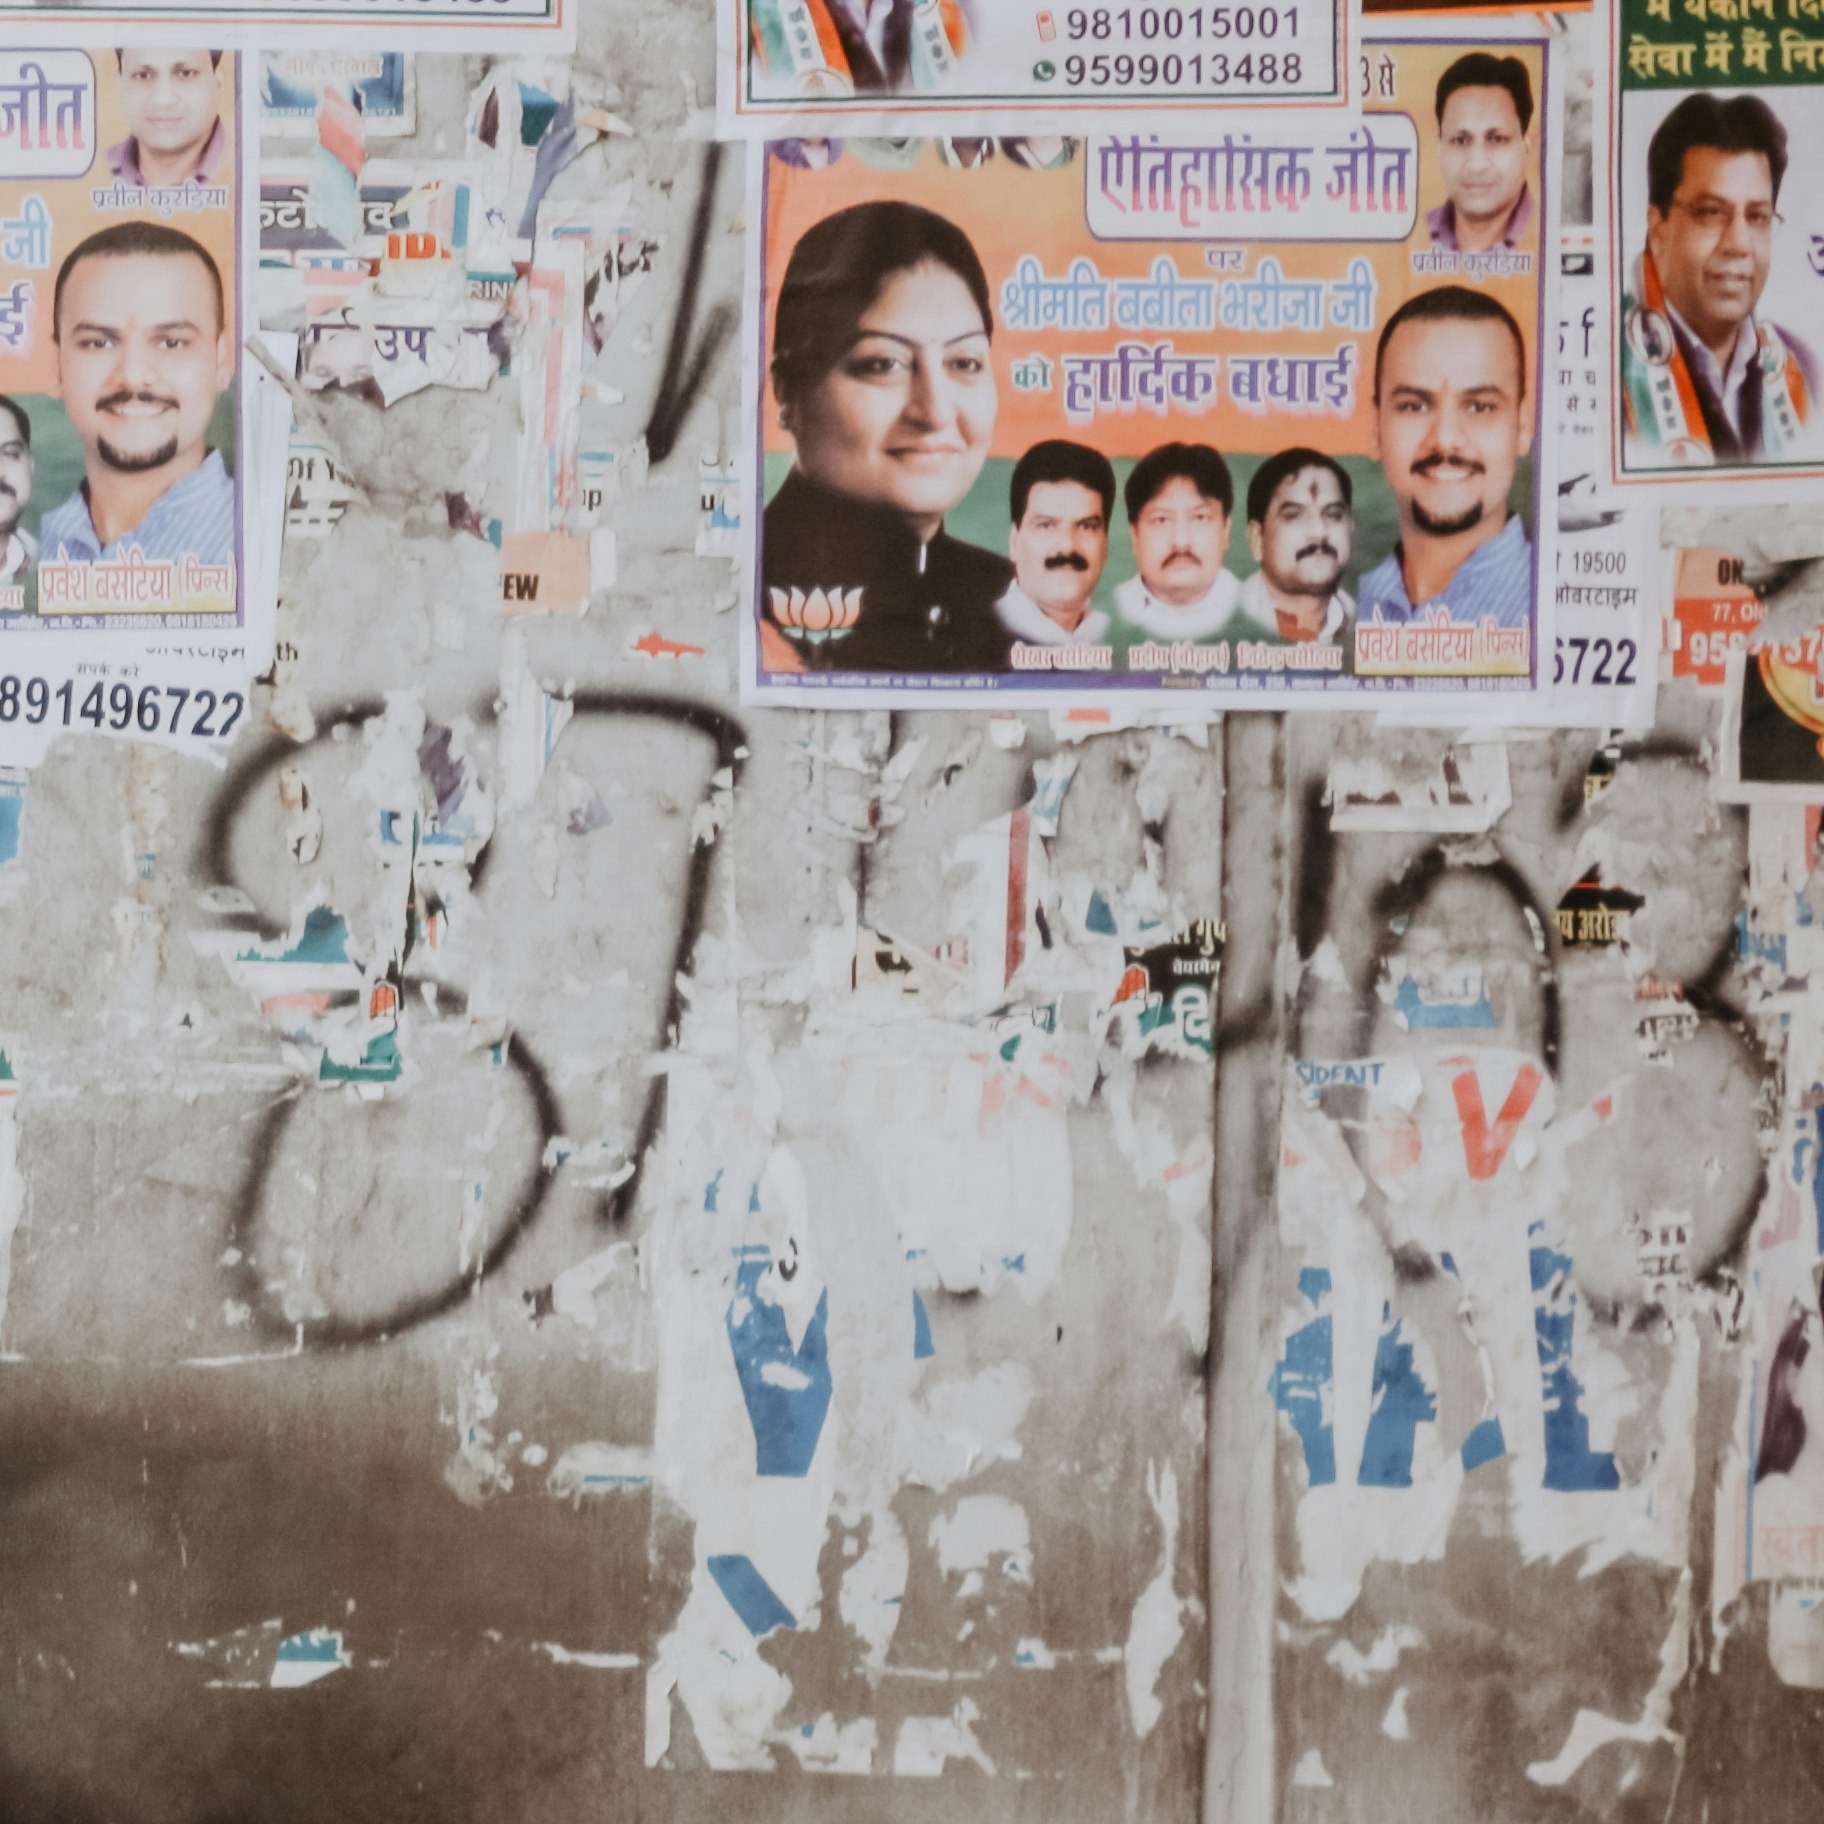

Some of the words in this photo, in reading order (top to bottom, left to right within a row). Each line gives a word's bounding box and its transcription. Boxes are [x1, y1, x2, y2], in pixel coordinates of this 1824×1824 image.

[1067, 8, 1300, 40] 9810015001
[1066, 53, 1303, 87] 9599013488
[2, 195, 51, 268] जी
[1207, 249, 1245, 271] पर
[1328, 253, 1374, 325] जी
[1063, 343, 1215, 412] हार्दिक
[1228, 342, 1353, 405] बधाई
[1572, 552, 1627, 575] 19500
